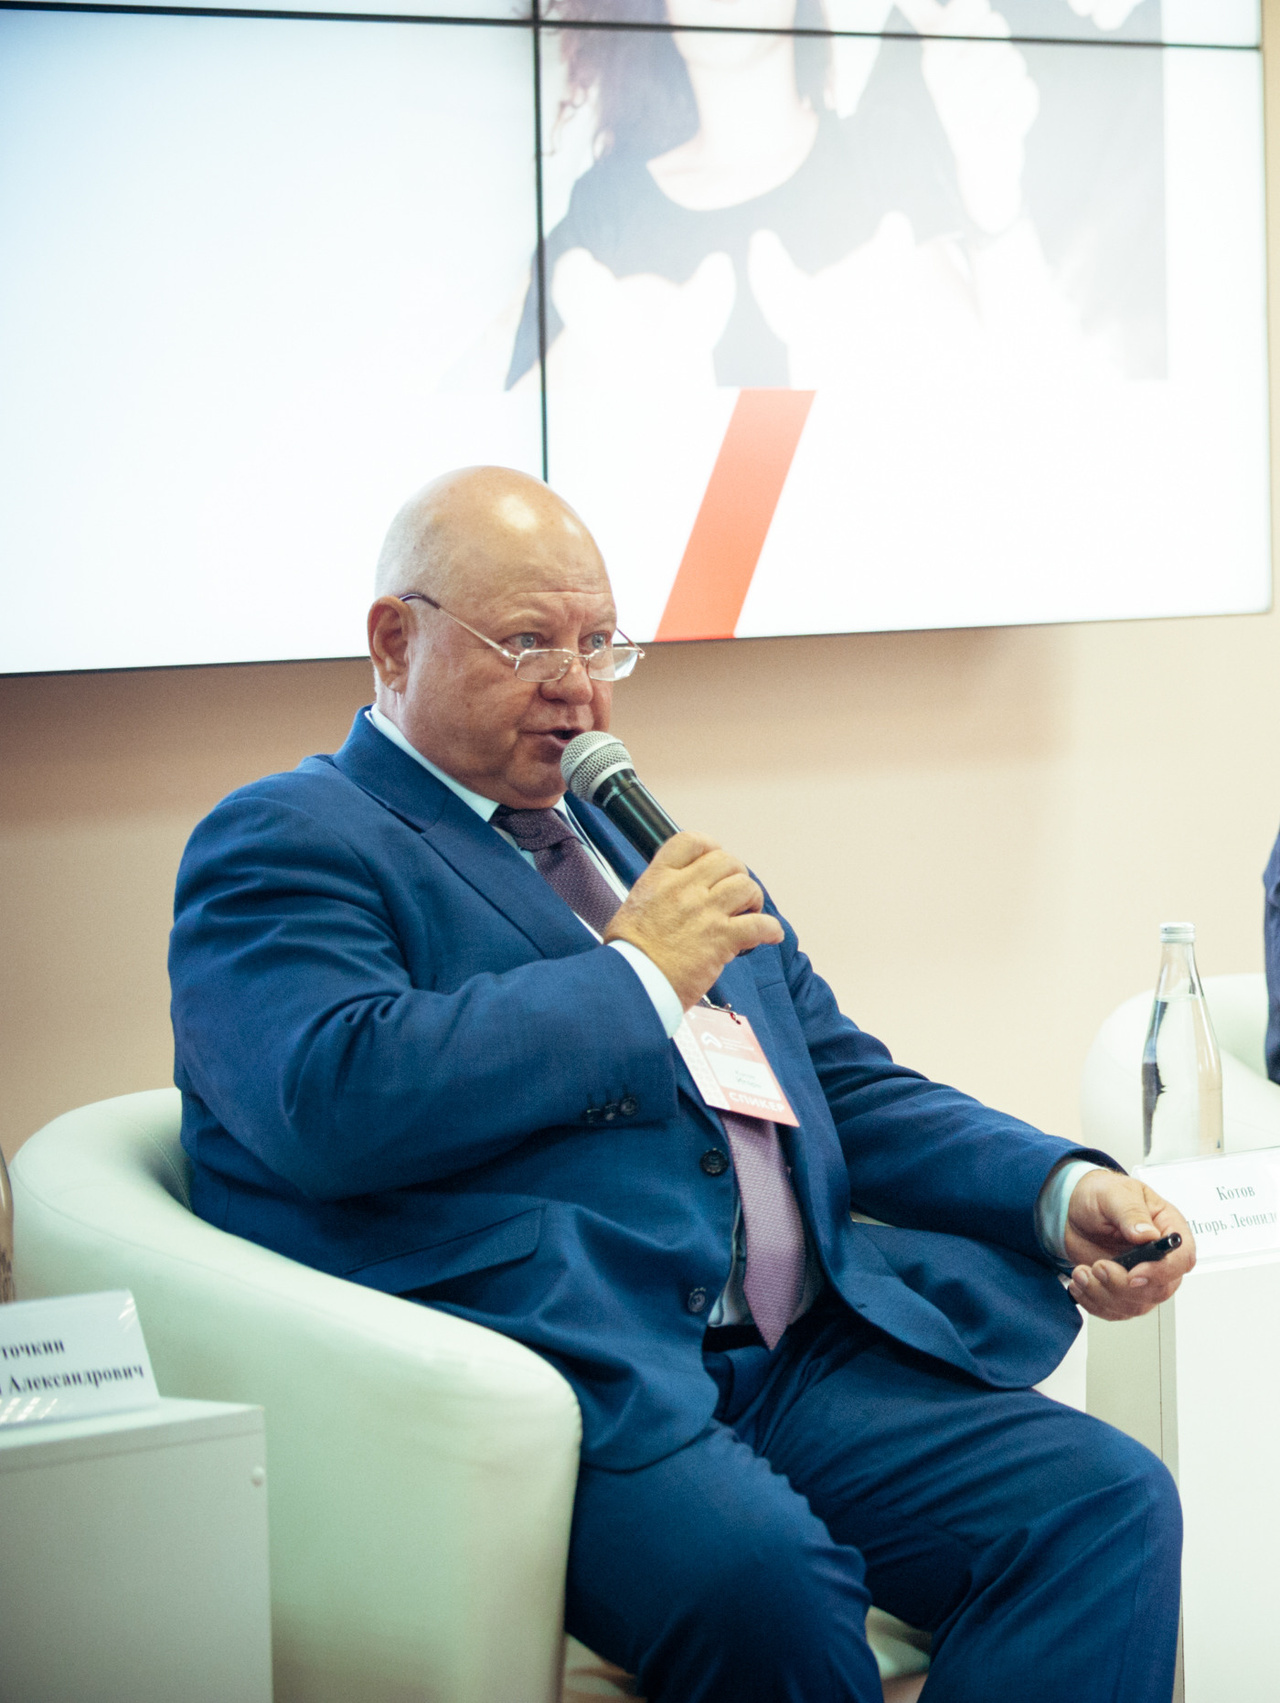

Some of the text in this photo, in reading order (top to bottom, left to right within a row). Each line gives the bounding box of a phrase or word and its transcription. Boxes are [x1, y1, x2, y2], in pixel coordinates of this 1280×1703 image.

[730, 1092, 785, 1112] СПИКЕР
[1216, 1186, 1256, 1201] Котов
[9, 1364, 144, 1393] Александрович
